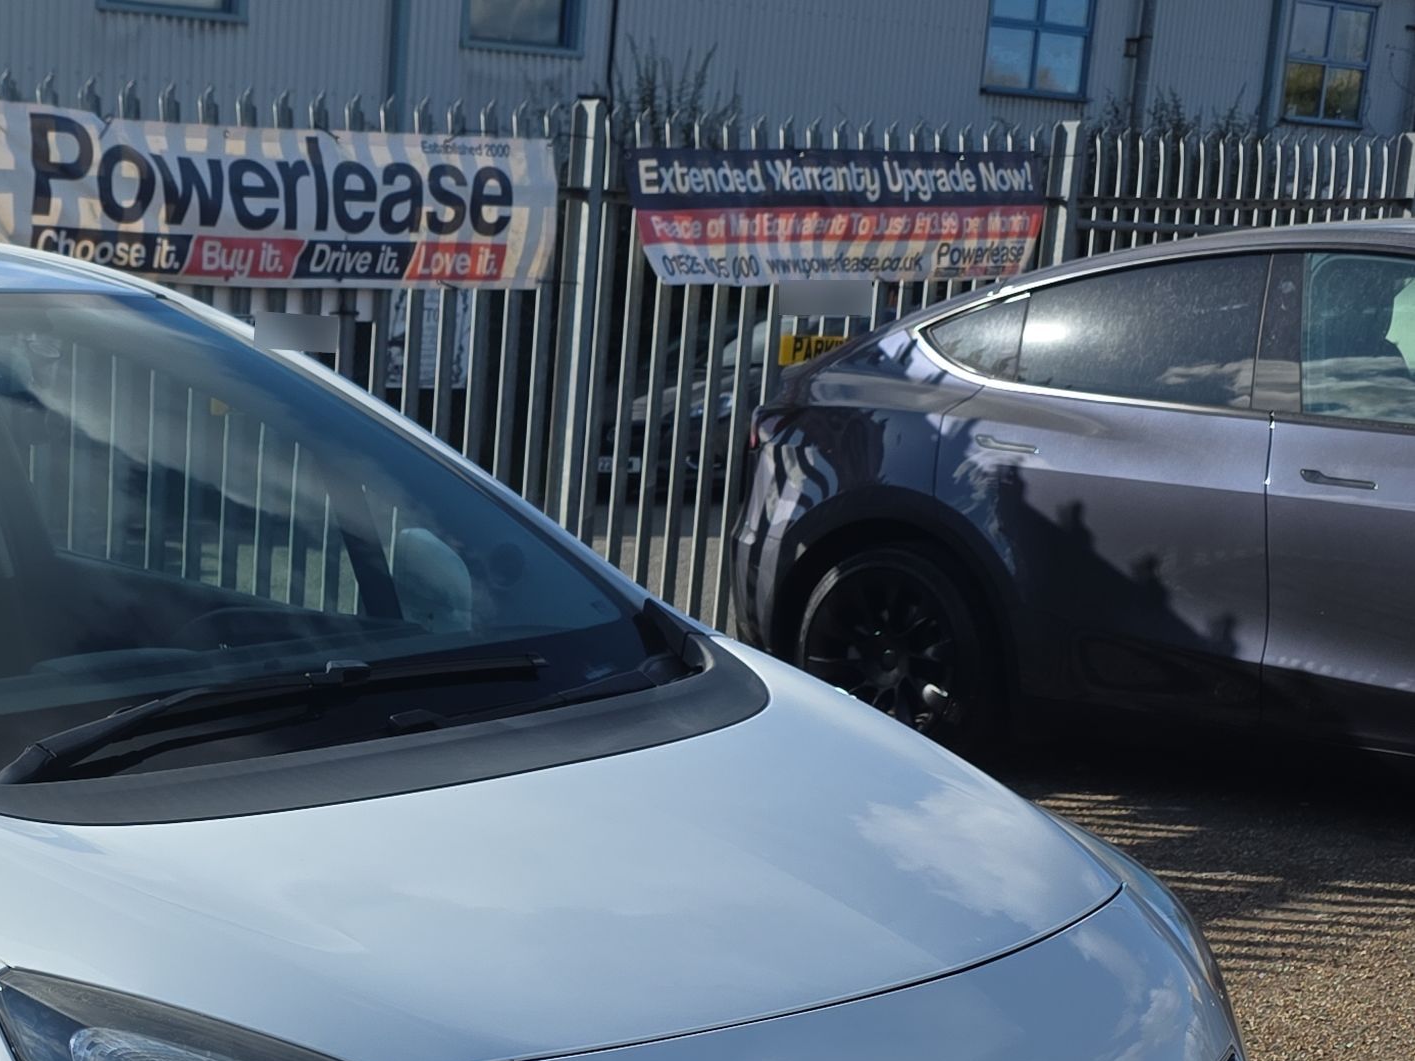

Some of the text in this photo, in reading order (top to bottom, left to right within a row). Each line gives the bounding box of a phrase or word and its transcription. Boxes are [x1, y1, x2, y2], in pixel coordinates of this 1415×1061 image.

[30, 112, 514, 236] Powerlease
[638, 157, 1033, 202] Extended Warranty Upgrade Now!
[651, 215, 703, 240] Peace
[706, 213, 727, 240] of
[851, 212, 871, 236] To
[875, 213, 910, 235] Just
[963, 216, 984, 238] per
[38, 229, 498, 276] Choose it. Buy it. Drive it. Love it.
[937, 241, 1025, 266] Powerlease
